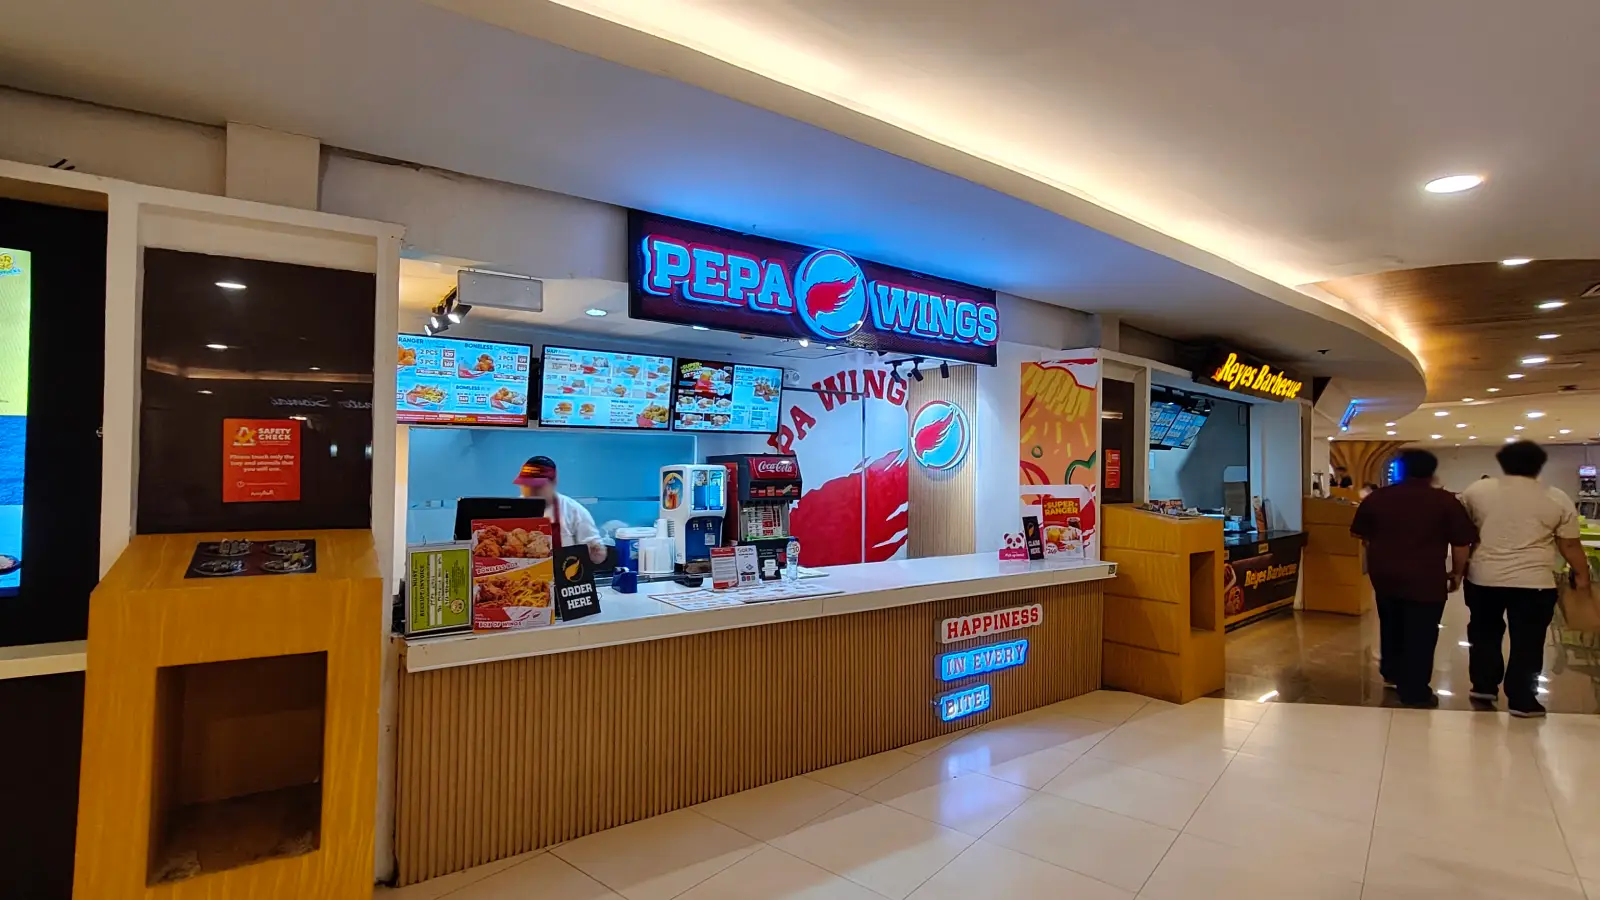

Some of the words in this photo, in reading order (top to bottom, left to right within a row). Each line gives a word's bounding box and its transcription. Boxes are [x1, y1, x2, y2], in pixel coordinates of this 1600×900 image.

[649, 238, 794, 309] PEPA
[873, 282, 999, 344] WINGS
[1220, 352, 1258, 391] Reyes
[1252, 364, 1303, 399] Barbecue
[811, 368, 909, 413] WING
[758, 461, 793, 473] Coca-Cola
[1044, 507, 1078, 516] RANGER
[1046, 500, 1075, 509] SUPER
[476, 564, 506, 575] BONELESS
[505, 562, 519, 570] BOX
[1243, 569, 1267, 590] Reyes
[1267, 563, 1298, 580] Barbecue
[560, 583, 593, 598] ORDER
[566, 596, 593, 610] HERE
[478, 620, 492, 628] BOX
[492, 620, 502, 628] OF
[501, 620, 522, 628] WINGS
[946, 606, 1040, 640] HAPPINESS
[946, 656, 967, 677] IN
[973, 643, 1026, 671] EVERY
[945, 688, 989, 717] BITE!
